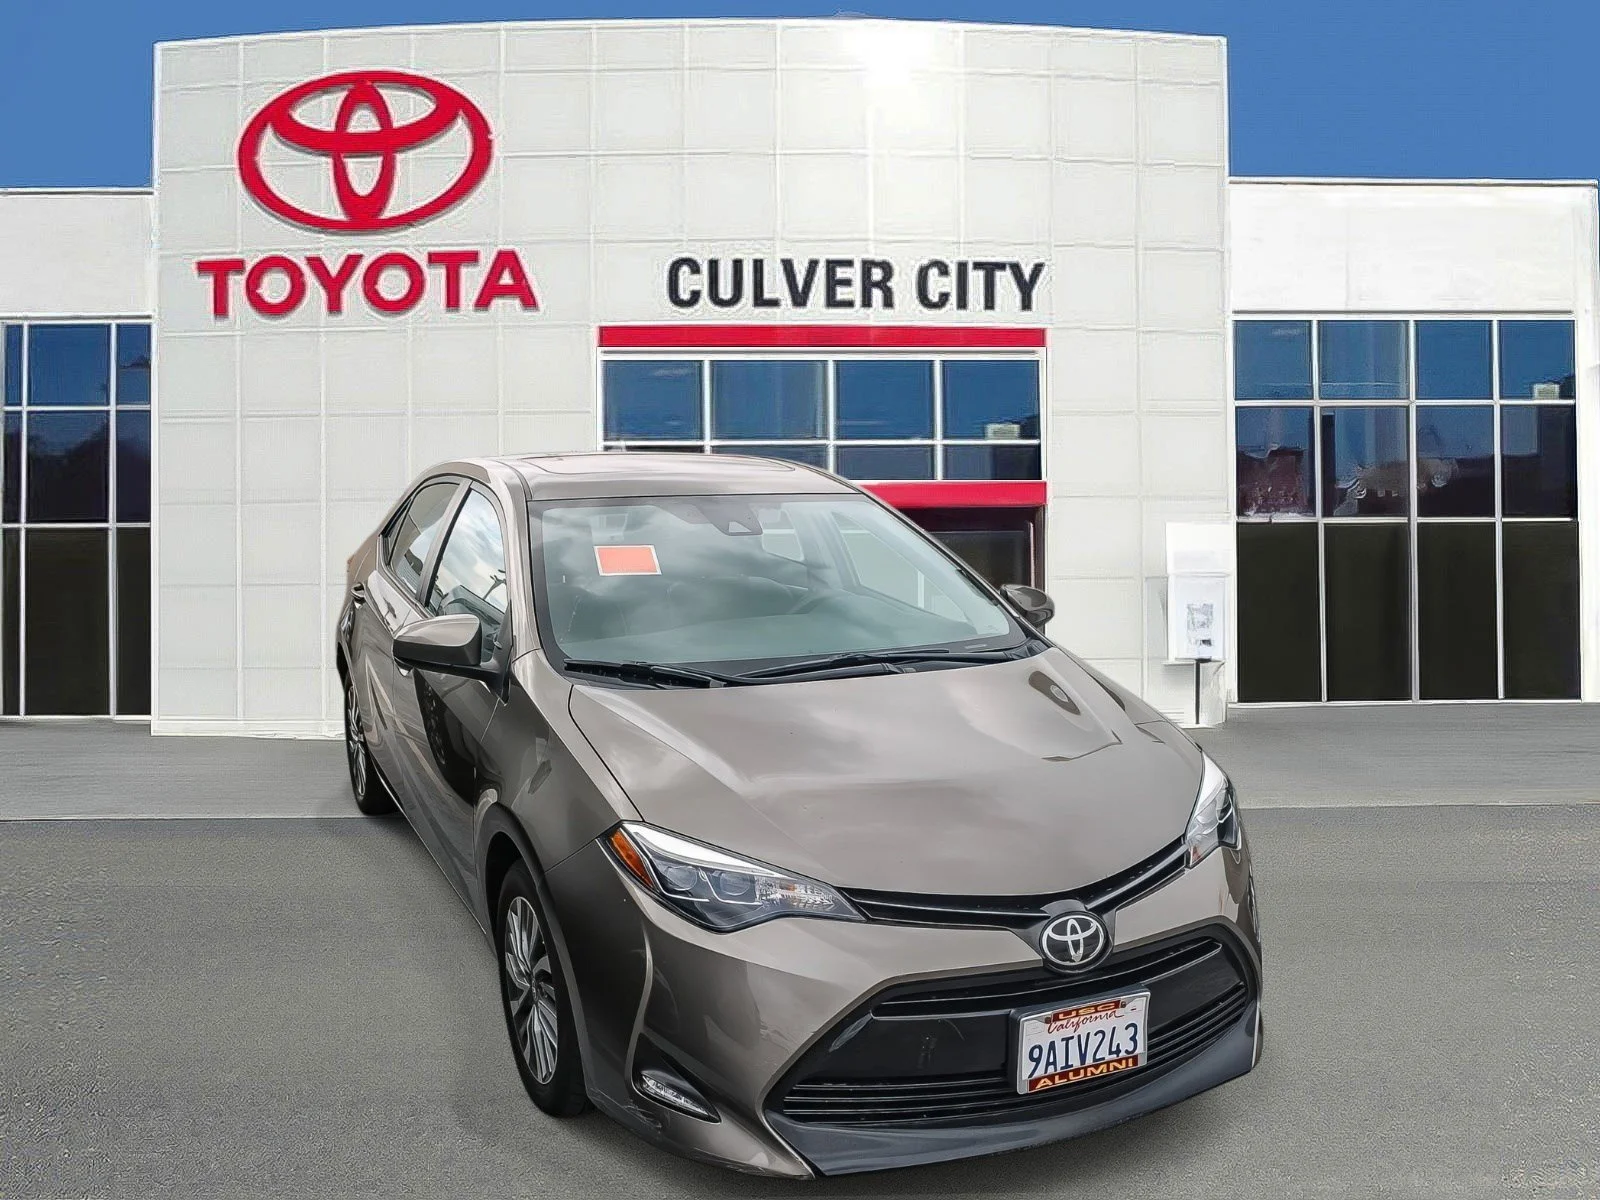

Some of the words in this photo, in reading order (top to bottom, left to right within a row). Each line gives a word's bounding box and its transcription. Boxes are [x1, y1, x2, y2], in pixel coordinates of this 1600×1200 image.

[197, 250, 538, 318] TOYOTA
[668, 257, 895, 309] CULVER
[916, 260, 1046, 311] CITY
[1047, 1009, 1124, 1034] California
[1058, 1002, 1116, 1020] USC
[1027, 1022, 1138, 1079] 9AIV243
[1035, 1057, 1133, 1089] ALUMNI
